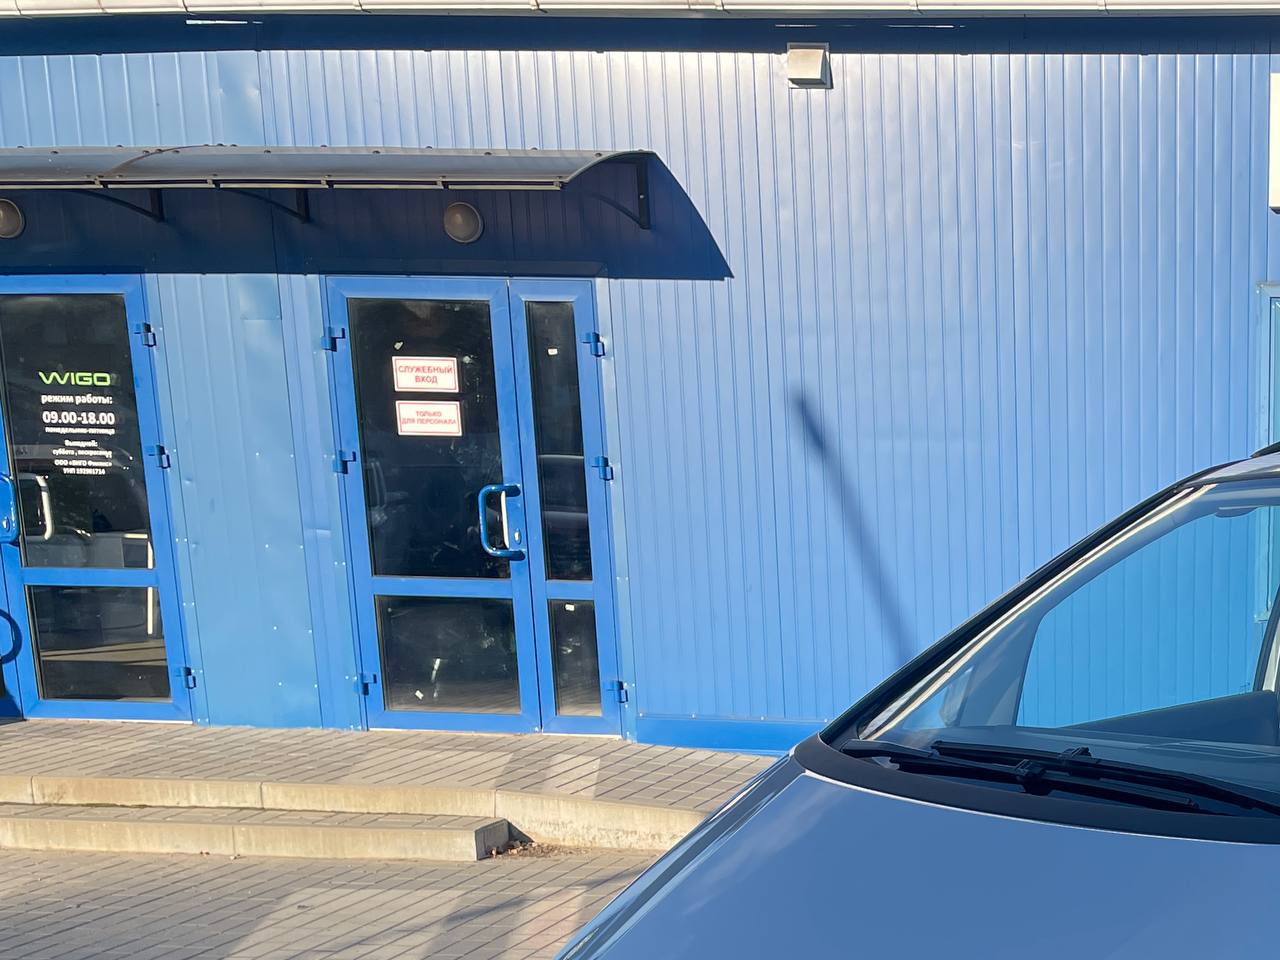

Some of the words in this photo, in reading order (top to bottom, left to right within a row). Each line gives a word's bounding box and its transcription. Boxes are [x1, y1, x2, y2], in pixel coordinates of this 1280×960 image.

[398, 365, 453, 374] СЛУЖЕБНЫЙ
[38, 371, 111, 386] WIGO
[415, 375, 438, 384] ВХОД
[41, 394, 74, 405] режим
[75, 393, 113, 405] работы:
[42, 410, 116, 425] 09.00-18.00
